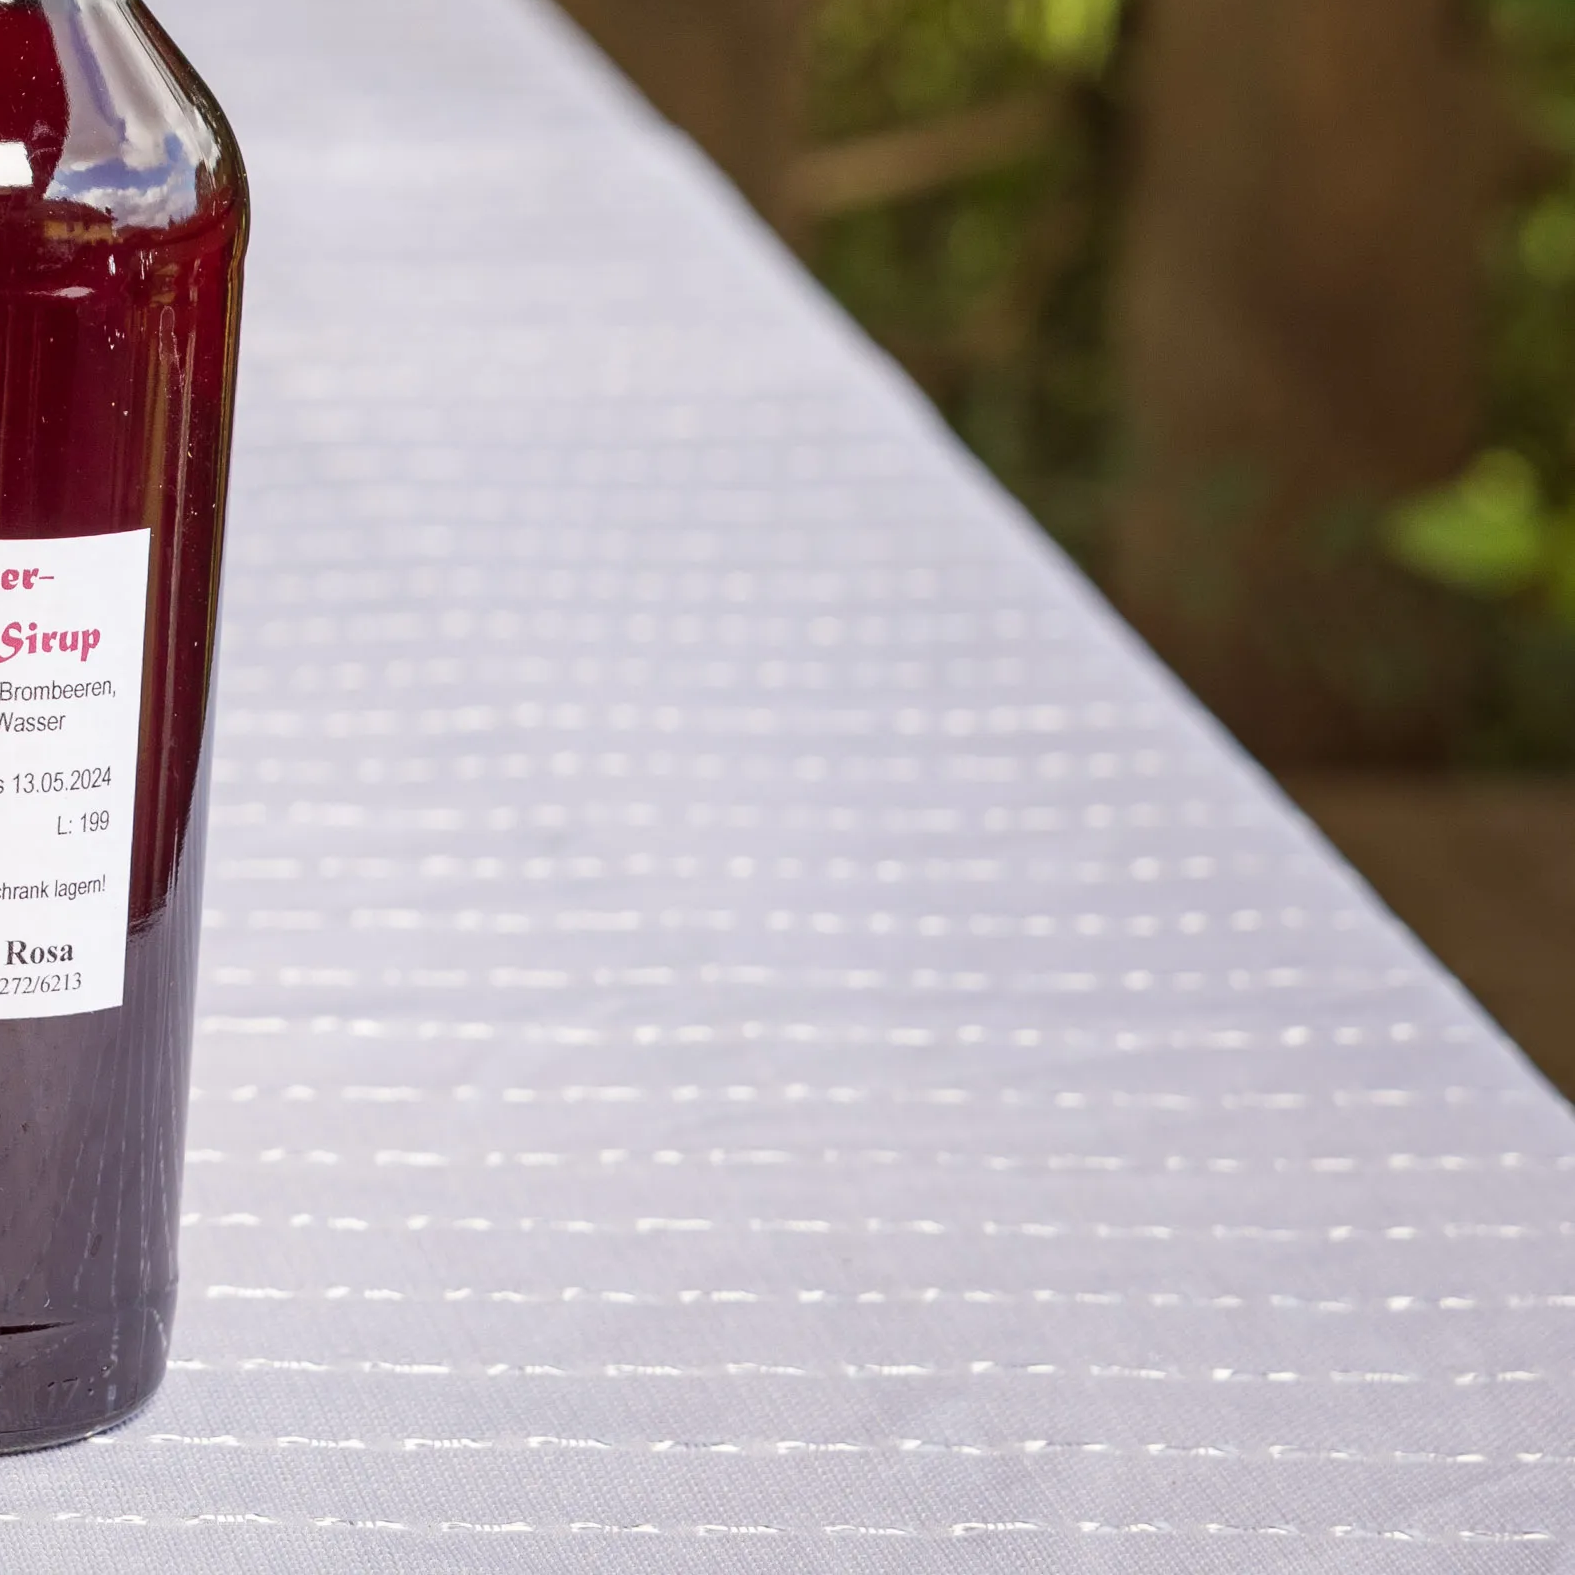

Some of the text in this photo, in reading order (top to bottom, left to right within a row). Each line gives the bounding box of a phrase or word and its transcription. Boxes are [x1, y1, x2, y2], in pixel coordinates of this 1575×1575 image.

[13, 766, 112, 794] 13.05.2024
[57, 810, 110, 835] L: 199
[53, 875, 106, 901] lagern!
[5, 940, 73, 965] Rosa
